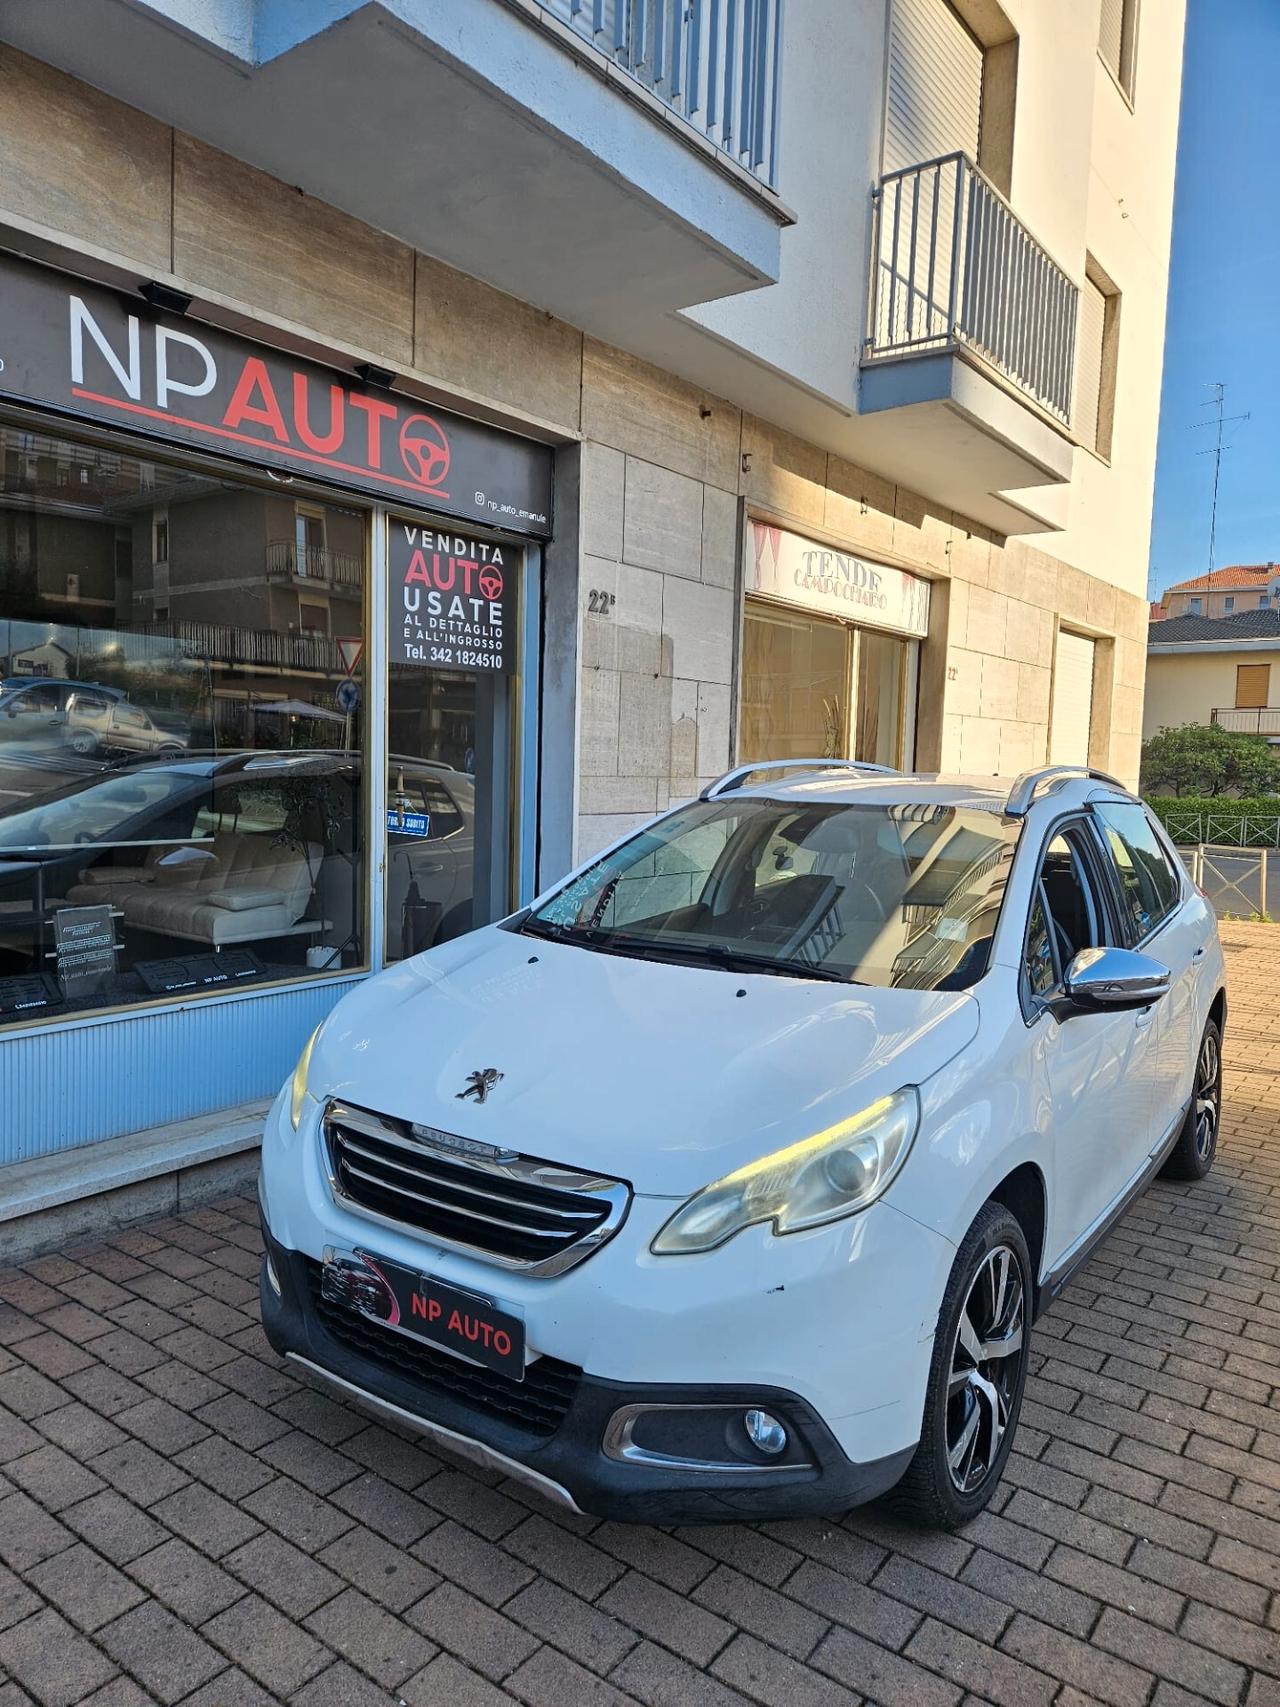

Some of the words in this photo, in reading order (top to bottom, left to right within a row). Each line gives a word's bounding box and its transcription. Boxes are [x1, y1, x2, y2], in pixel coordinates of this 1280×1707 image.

[69, 294, 218, 408] NP
[222, 355, 450, 487] AUTO
[404, 525, 504, 565] VENDITA
[404, 549, 503, 600] AUTO
[802, 551, 882, 593] TENDE
[403, 586, 503, 625] USATE
[404, 614, 422, 626] AL
[429, 617, 503, 638] DETTAGLIO
[404, 628, 411, 638] E
[416, 629, 503, 650] ALL'INGROSSO
[404, 643, 427, 660] Tel.
[430, 646, 453, 663] 342
[455, 649, 503, 669] 1824510
[411, 1292, 442, 1322] NP
[448, 1310, 512, 1356] AUTO
